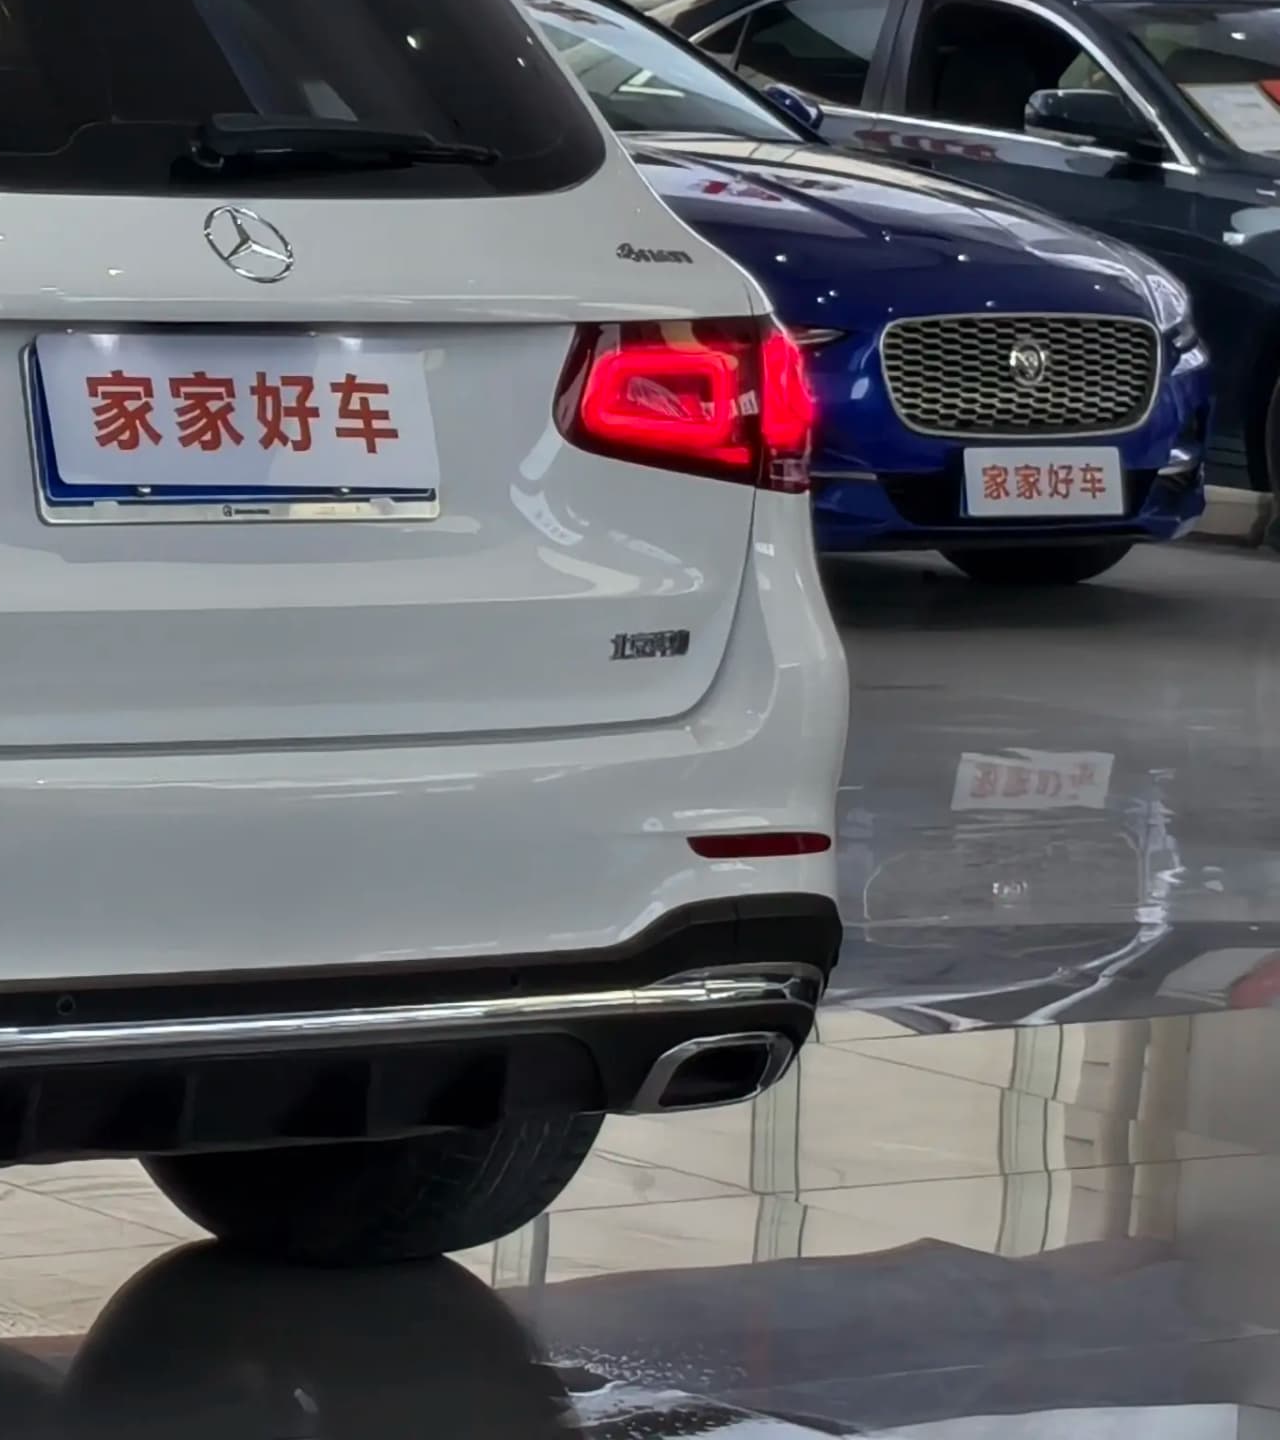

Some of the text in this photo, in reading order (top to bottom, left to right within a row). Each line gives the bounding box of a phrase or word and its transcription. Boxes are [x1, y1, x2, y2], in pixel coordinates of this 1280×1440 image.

[85, 369, 400, 455] 家家好车
[981, 461, 1107, 500] 家家好车
